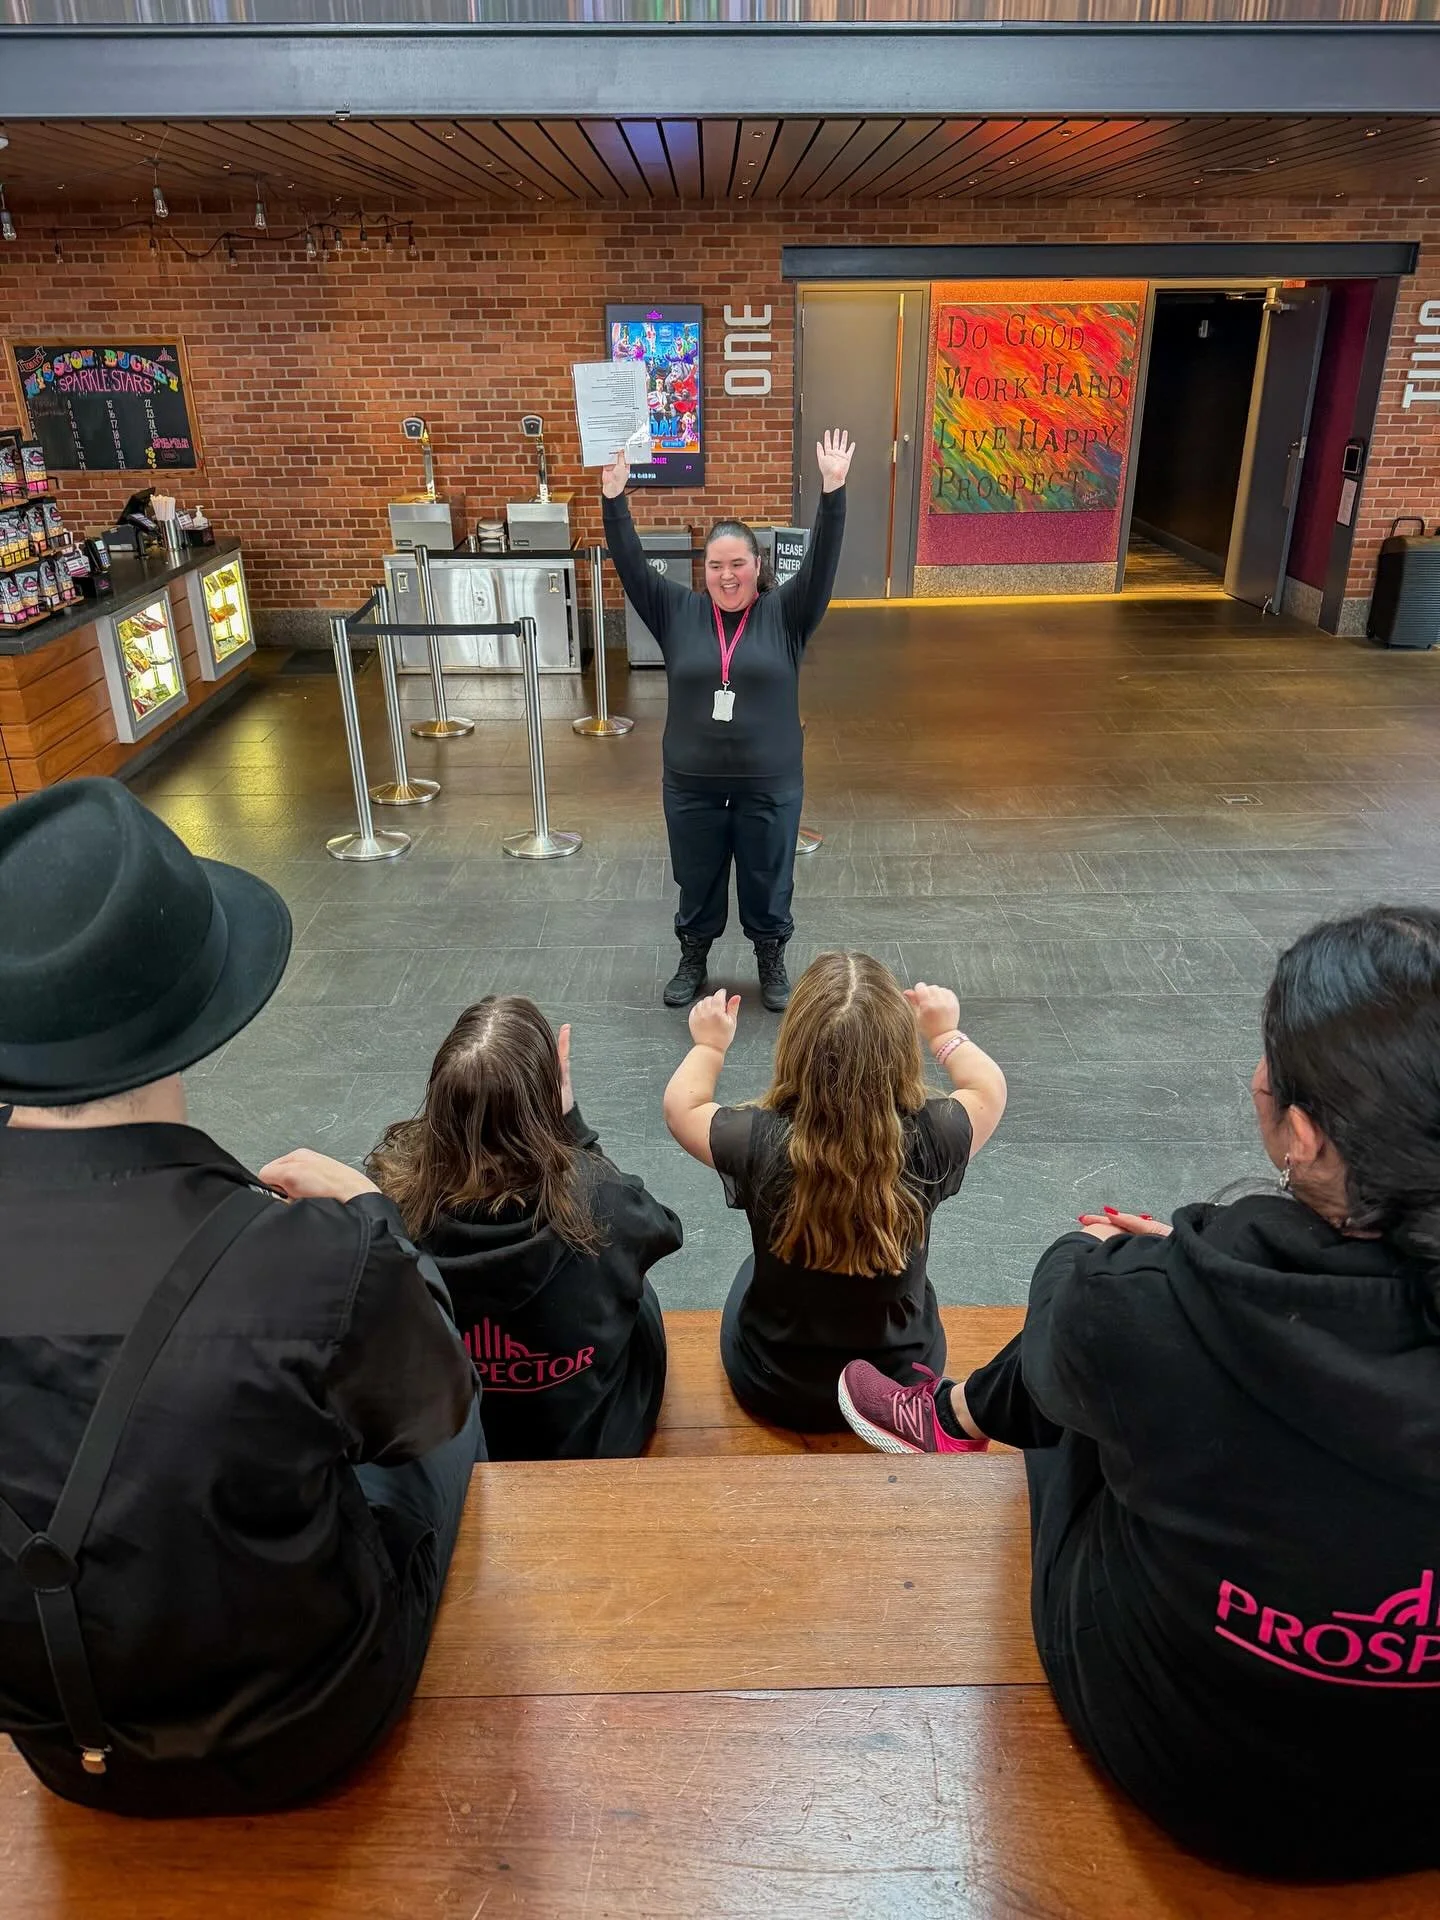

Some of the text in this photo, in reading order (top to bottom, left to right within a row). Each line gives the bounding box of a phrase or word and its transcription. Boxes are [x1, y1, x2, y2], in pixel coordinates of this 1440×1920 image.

[1005, 313, 1085, 350] GOOD
[724, 305, 771, 395] ONE
[59, 369, 153, 393] SPARKLE STARS
[944, 362, 1123, 401] WORK HARD
[938, 418, 1119, 454] LIVE HAPPY
[936, 466, 1085, 500] PROSPECT
[777, 543, 803, 556] PLEASE
[778, 557, 801, 571] ENTER
[1216, 1579, 1440, 1674] PROSP
